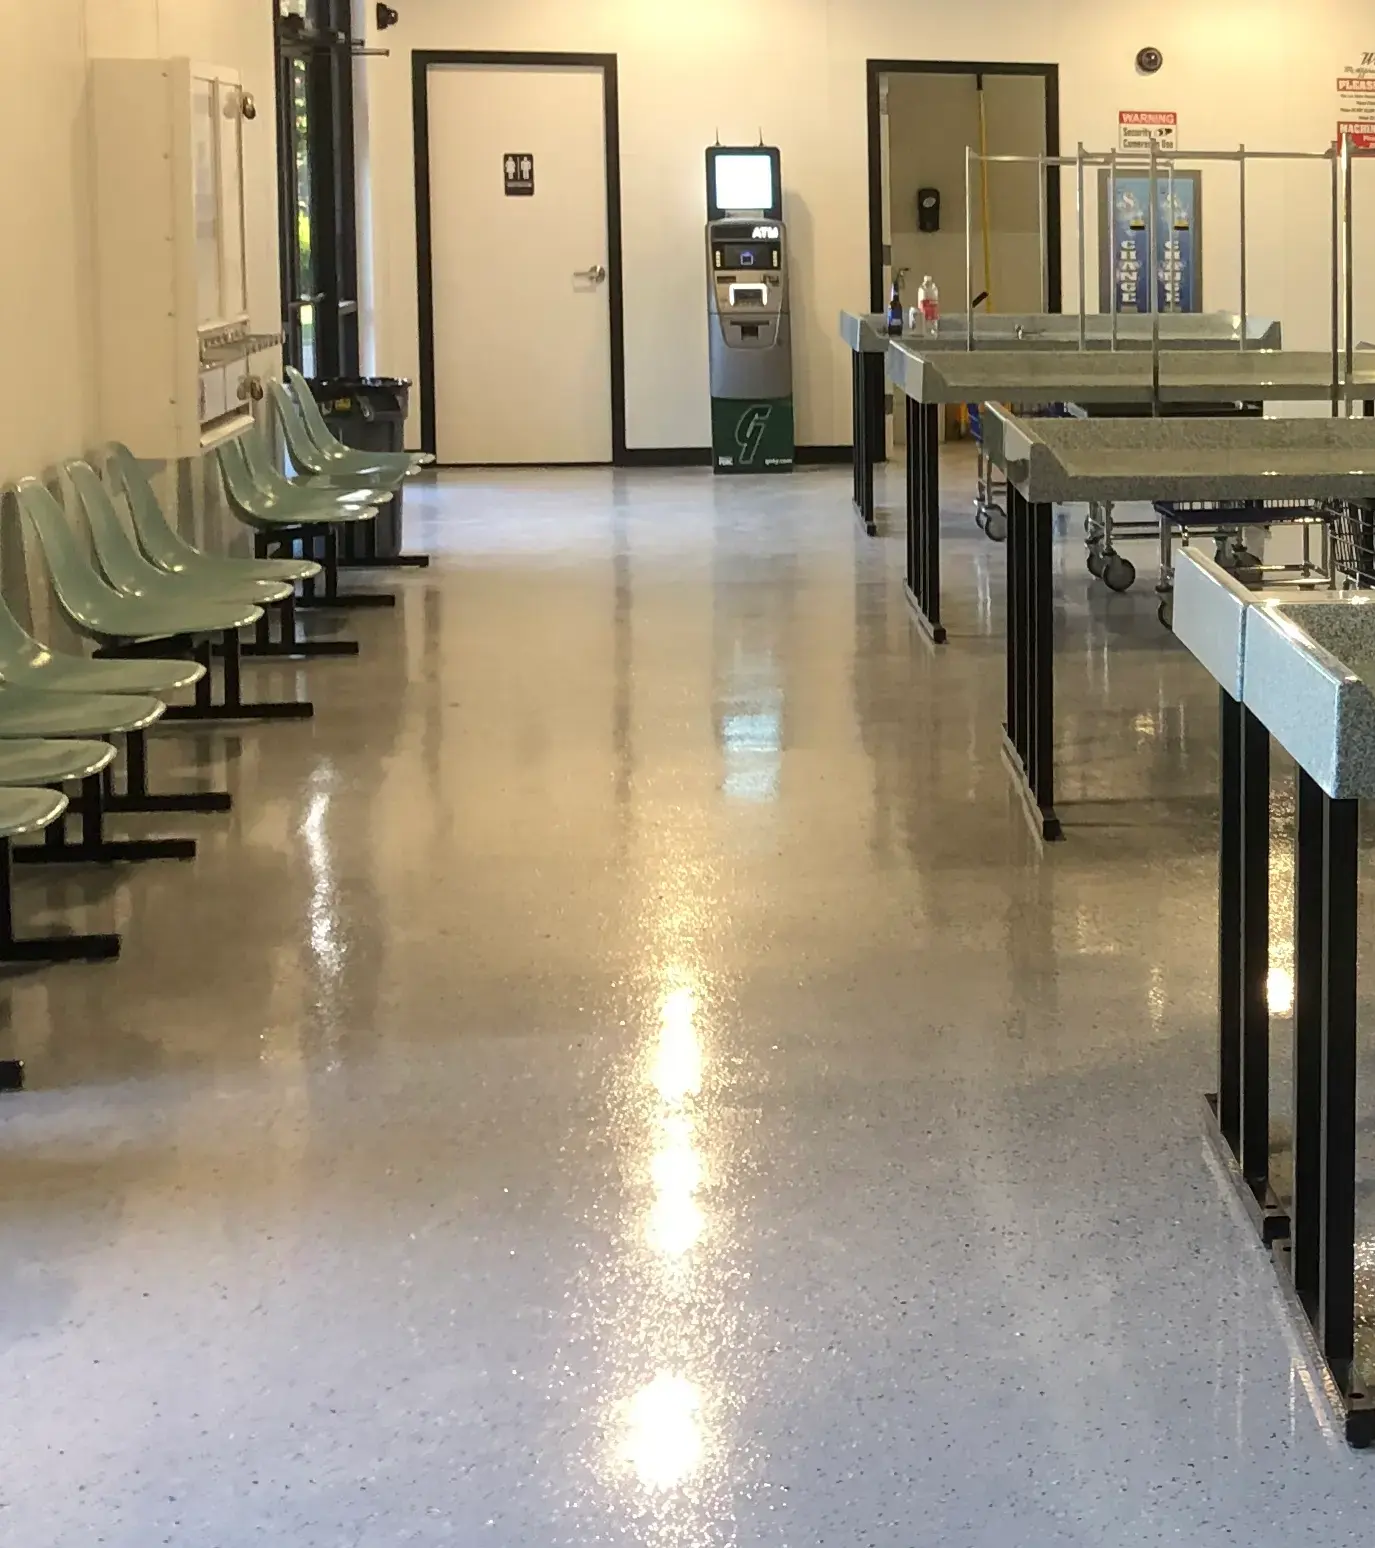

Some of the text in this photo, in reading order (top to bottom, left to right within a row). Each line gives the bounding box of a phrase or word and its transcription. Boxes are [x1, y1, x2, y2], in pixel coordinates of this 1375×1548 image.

[1122, 113, 1174, 124] WARNING
[1123, 127, 1151, 138] Security
[752, 226, 778, 239] ATM
[1121, 240, 1137, 303] CHANGE
[1164, 240, 1181, 303] CHANGE
